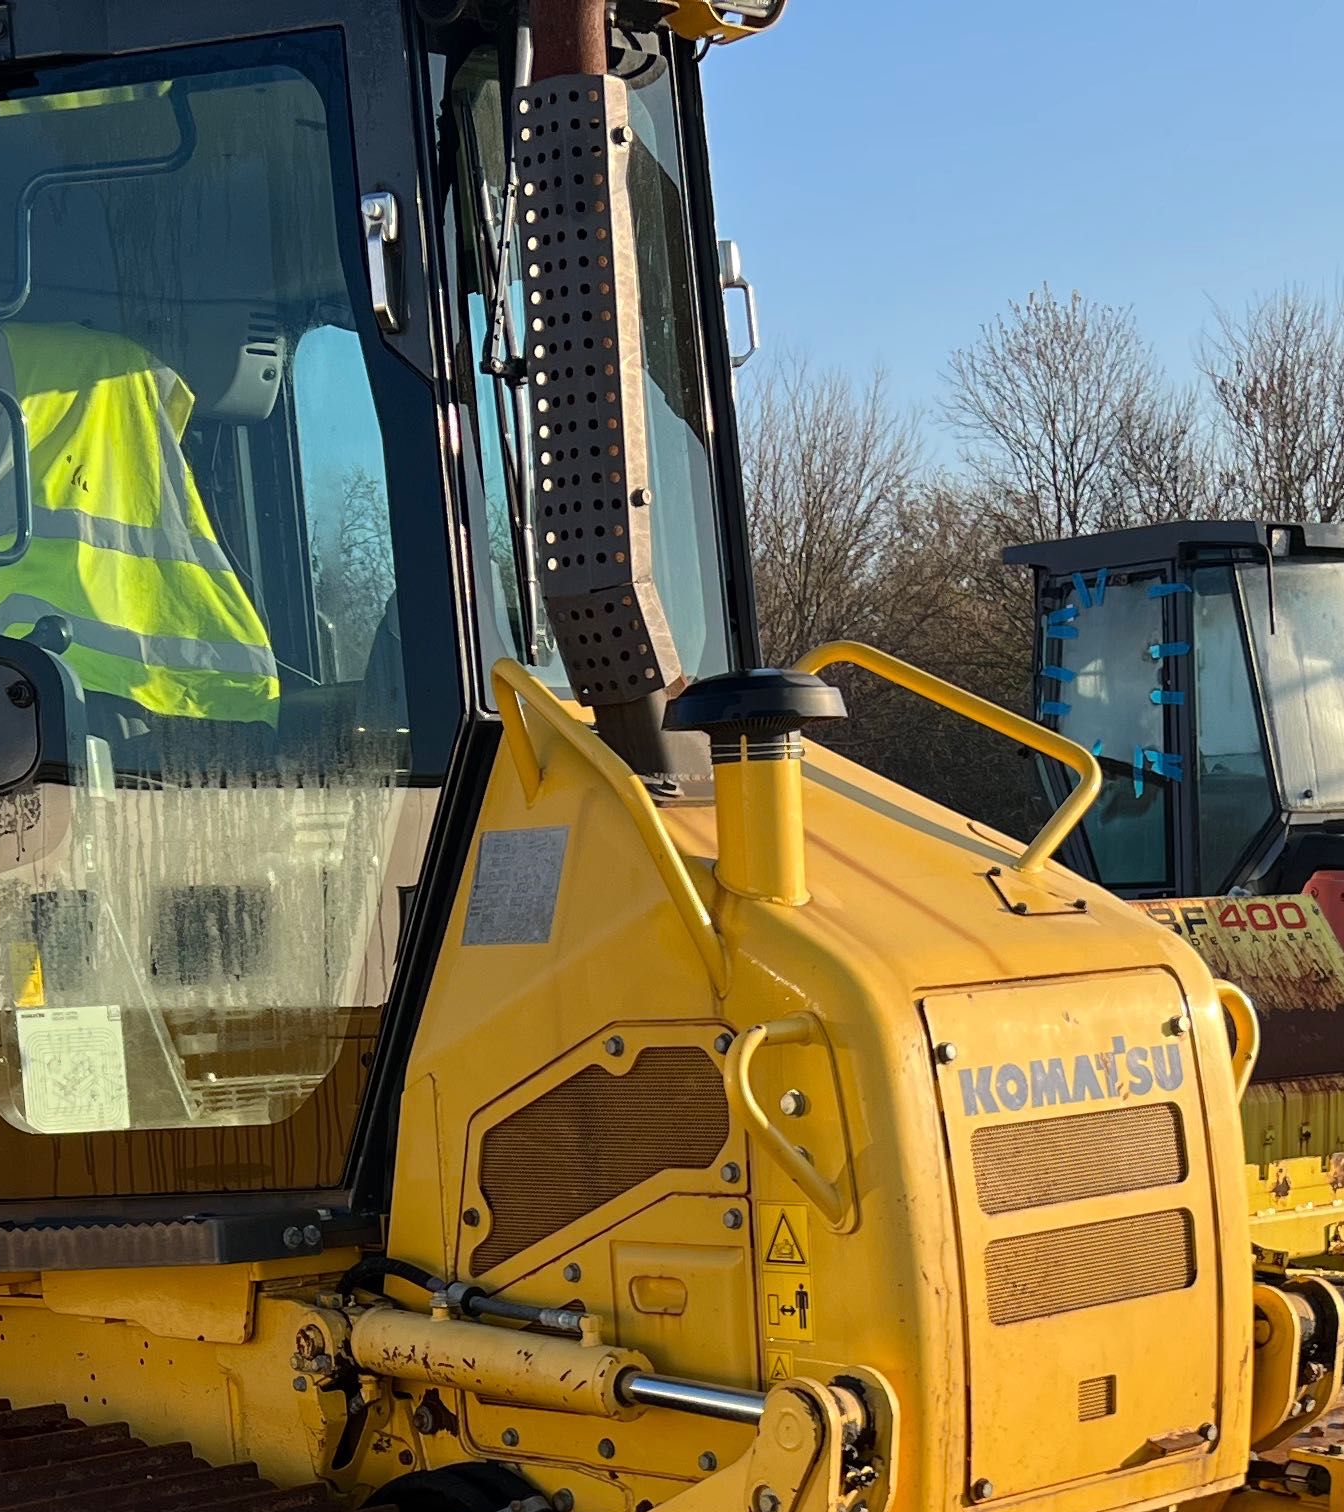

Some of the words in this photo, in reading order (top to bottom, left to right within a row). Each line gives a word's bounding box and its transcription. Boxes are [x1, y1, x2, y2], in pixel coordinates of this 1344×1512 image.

[1218, 902, 1307, 932] 400
[1190, 932, 1315, 947] DEPAVER
[957, 1035, 1184, 1117] KOMATSU
